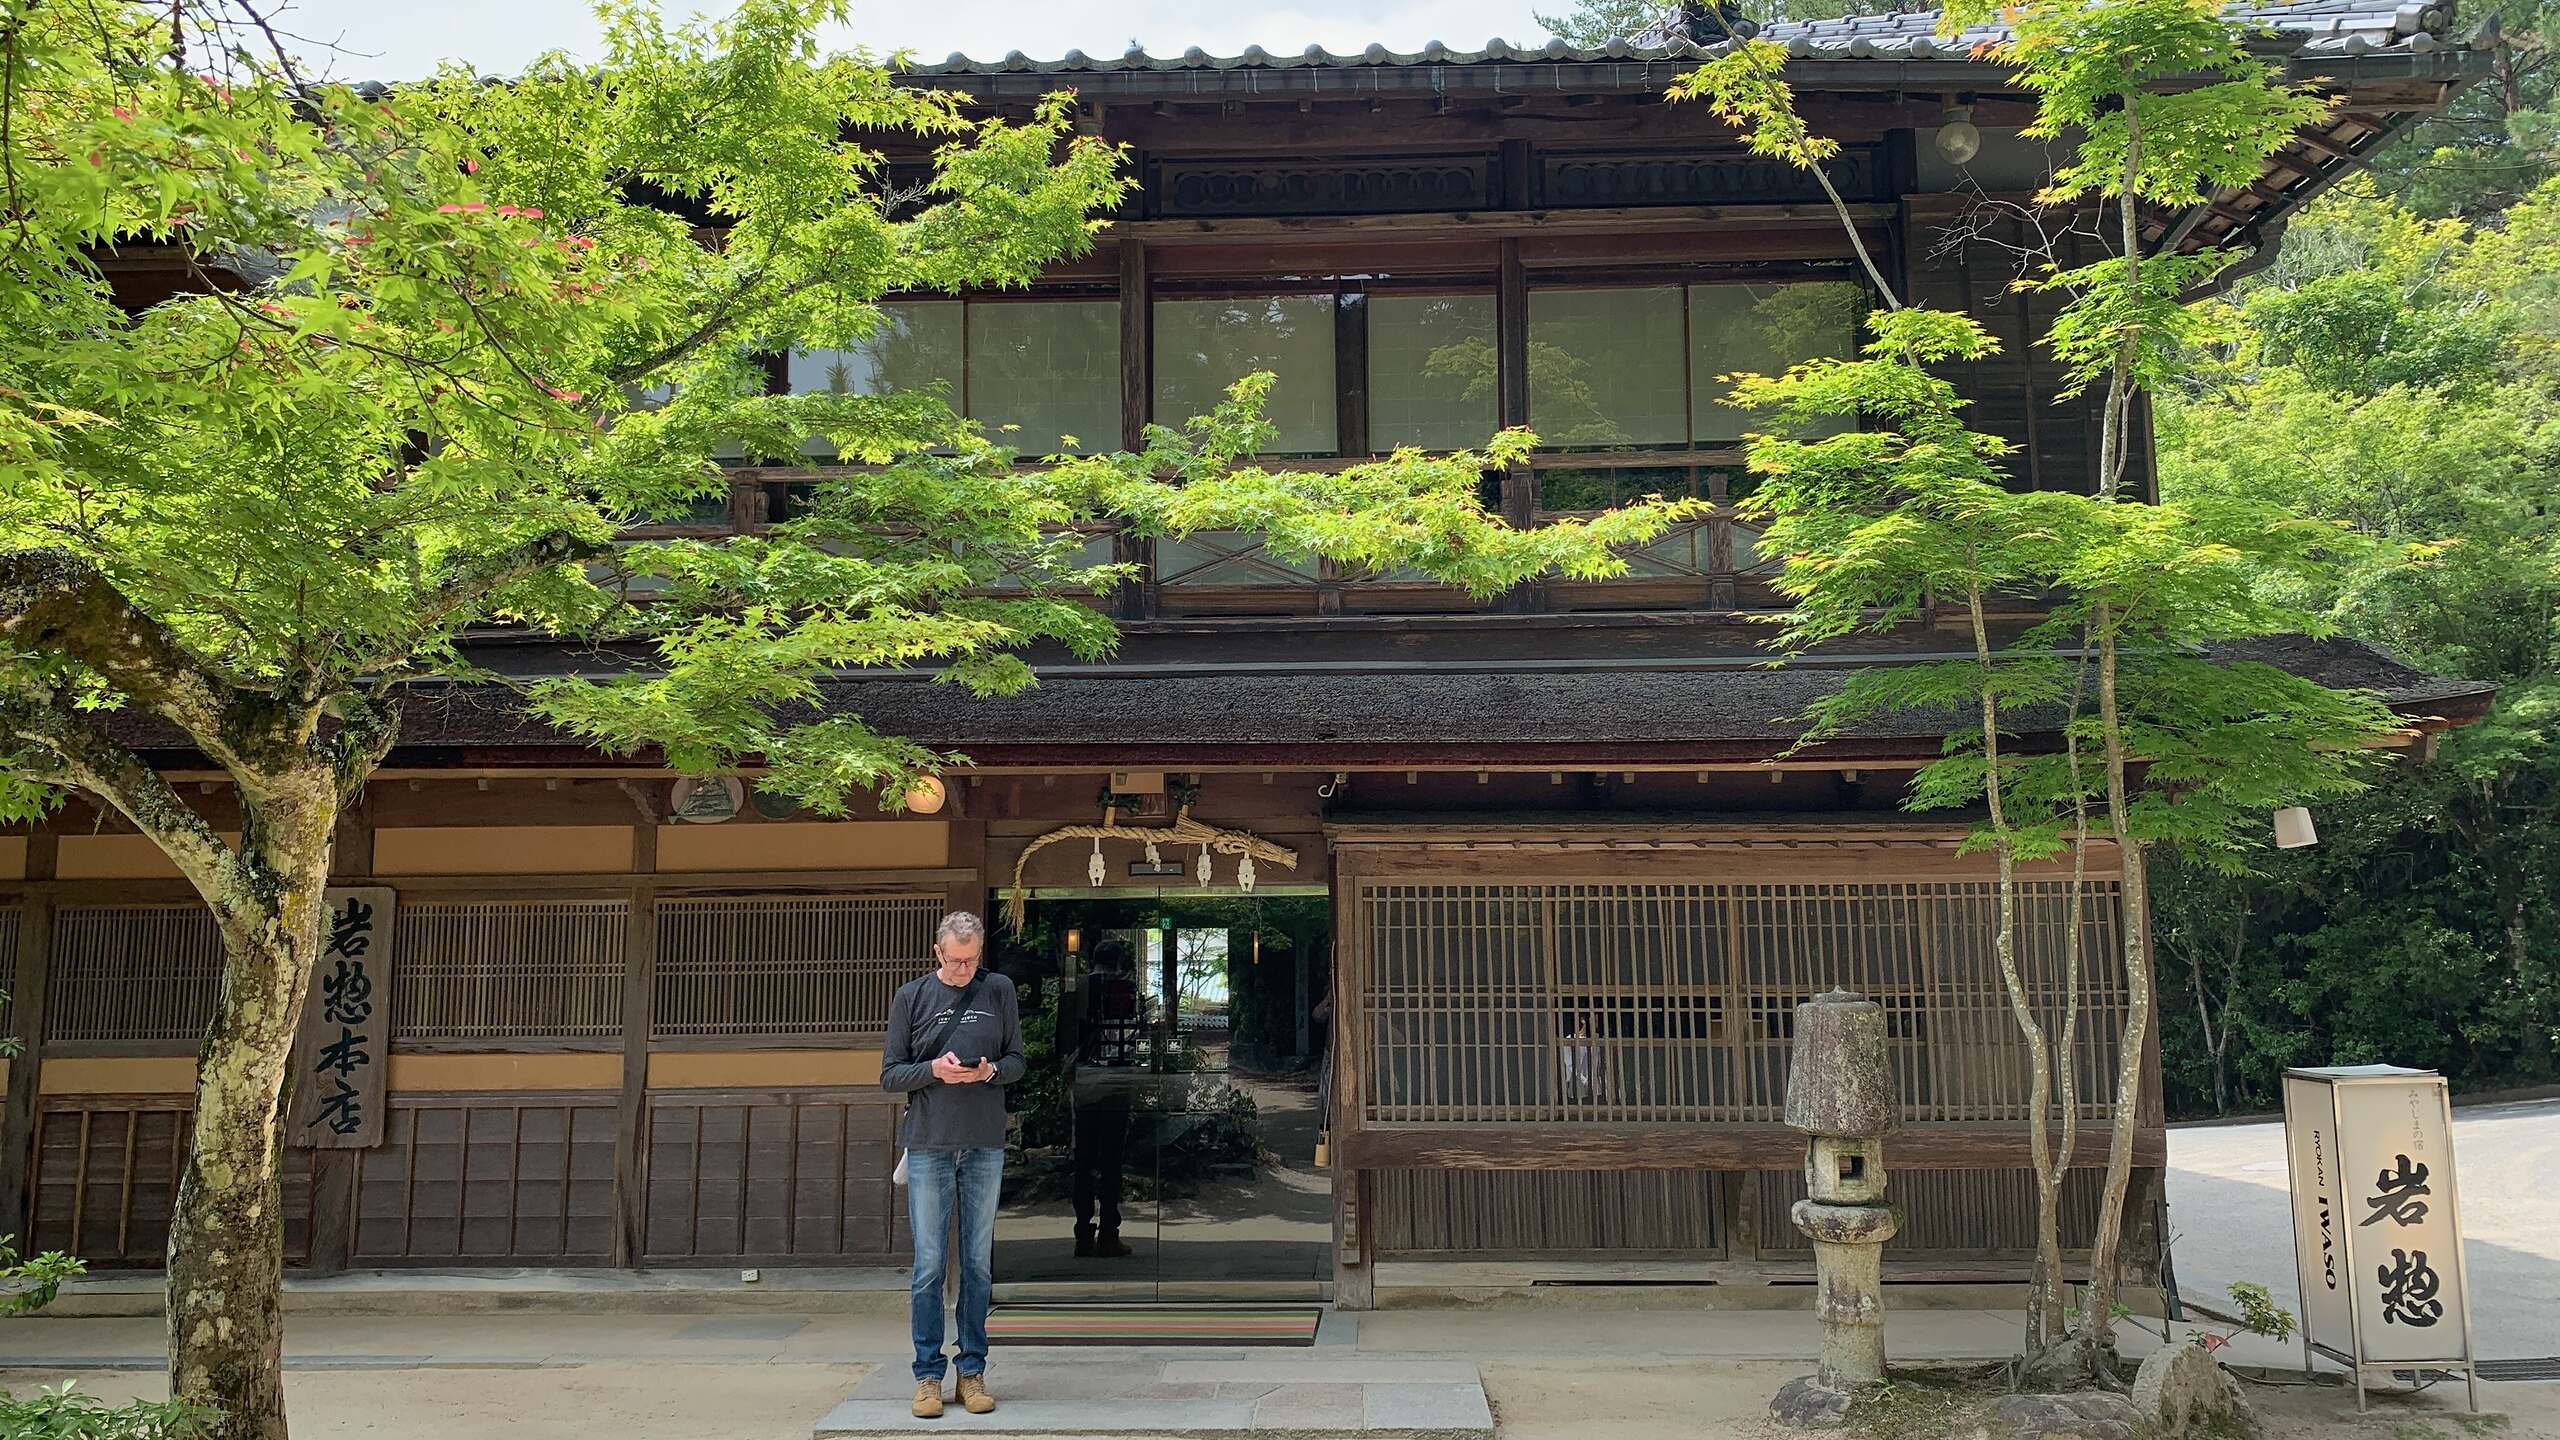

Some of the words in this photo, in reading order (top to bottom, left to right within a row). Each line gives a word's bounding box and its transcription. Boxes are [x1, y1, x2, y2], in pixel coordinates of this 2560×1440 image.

[307, 898, 373, 1134] 岩惣本店
[2313, 1130, 2325, 1186] RYOKAN
[2318, 1196, 2337, 1290] IWASO
[2358, 1154, 2443, 1327] 岩惣
